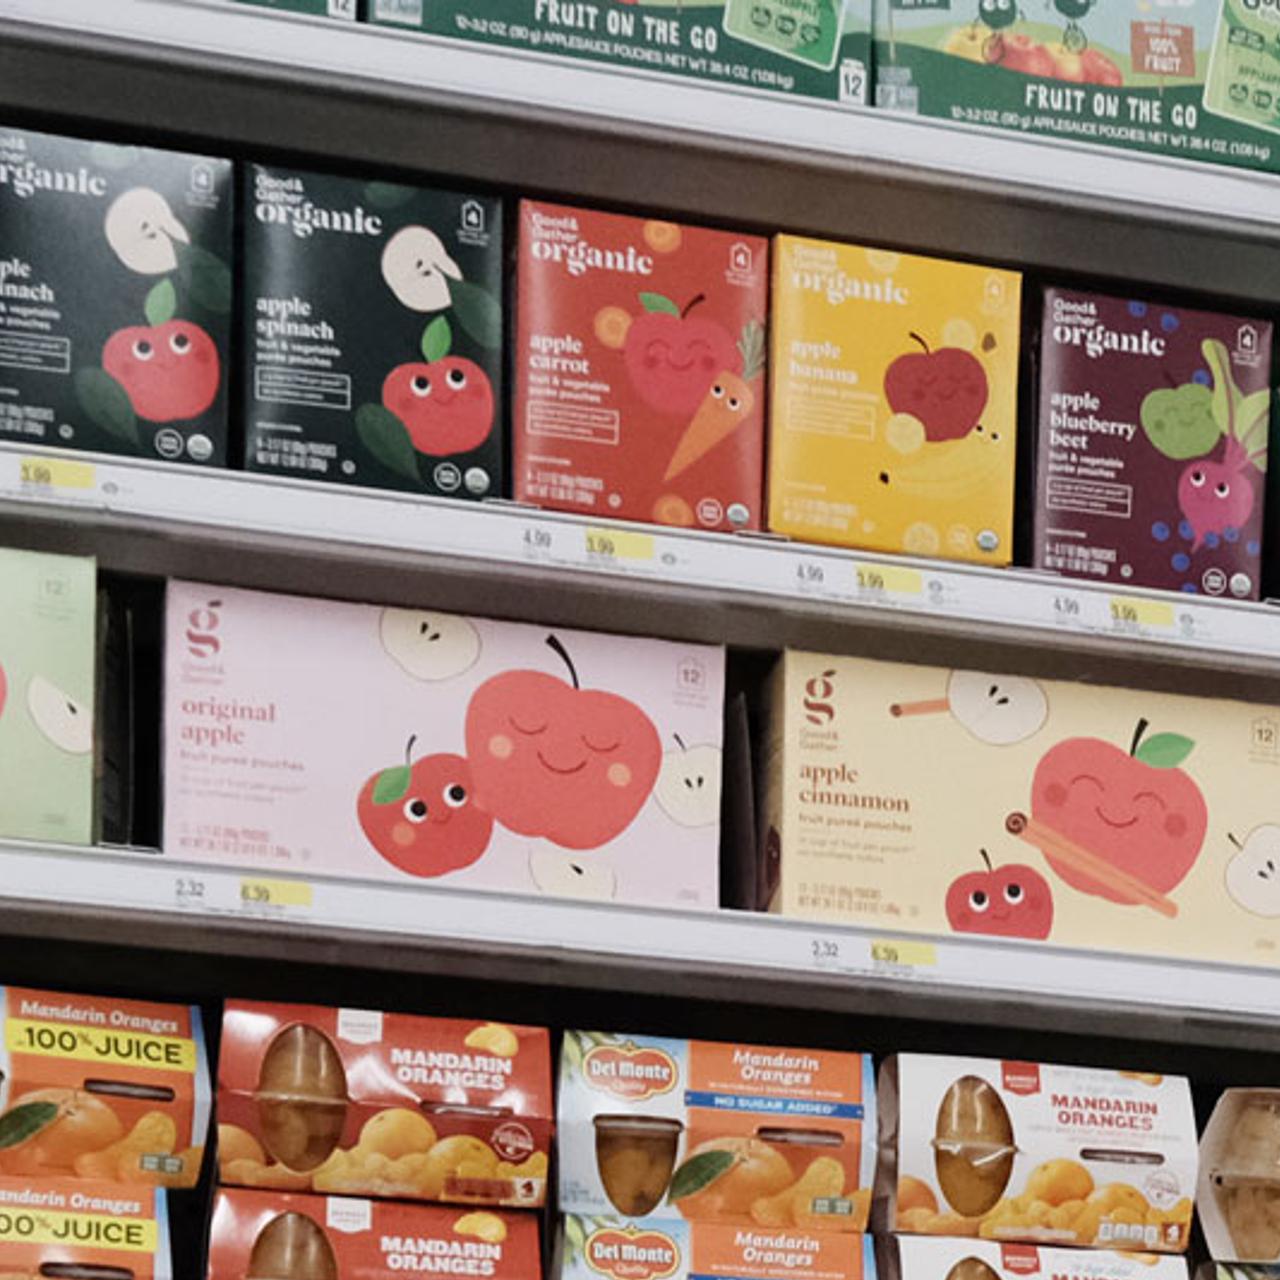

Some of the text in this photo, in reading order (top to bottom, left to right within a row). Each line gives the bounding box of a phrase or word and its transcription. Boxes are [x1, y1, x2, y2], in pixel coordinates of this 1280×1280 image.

[534, 1, 718, 52] FRUIT ON THE GO
[1025, 84, 1197, 129] FRUIT ON THE GO
[255, 200, 382, 238] organic
[531, 240, 653, 276] organic
[791, 271, 909, 305] organic
[256, 297, 312, 318] apple
[256, 315, 334, 342] spinach
[1053, 324, 1165, 357] organic
[529, 334, 583, 356] apple
[790, 340, 840, 360] apple
[528, 353, 590, 375] carrot
[788, 360, 858, 384] banana
[1050, 391, 1100, 412] apple
[1050, 410, 1137, 441] blueberry
[1049, 431, 1088, 450] beet
[181, 697, 277, 727] original
[181, 722, 245, 747] apple
[1255, 727, 1274, 743] 12
[800, 763, 858, 789] apple
[799, 786, 910, 814] cinnamon
[21, 1001, 179, 1033] Mandarin Oranges
[95, 1037, 182, 1064] JUICE
[391, 1048, 512, 1076] MANDARIN
[733, 1049, 820, 1073] Mandarin
[397, 1067, 506, 1091] ORANGES
[590, 1060, 671, 1082] Del Monte
[740, 1064, 813, 1086] Oranges
[714, 1097, 834, 1116] NO SUGAR ADDED
[1050, 1094, 1159, 1116] MANDARIN
[1057, 1110, 1155, 1132] ORANGES
[380, 1236, 501, 1261] MANDARIN
[387, 1255, 495, 1276] ORANGES
